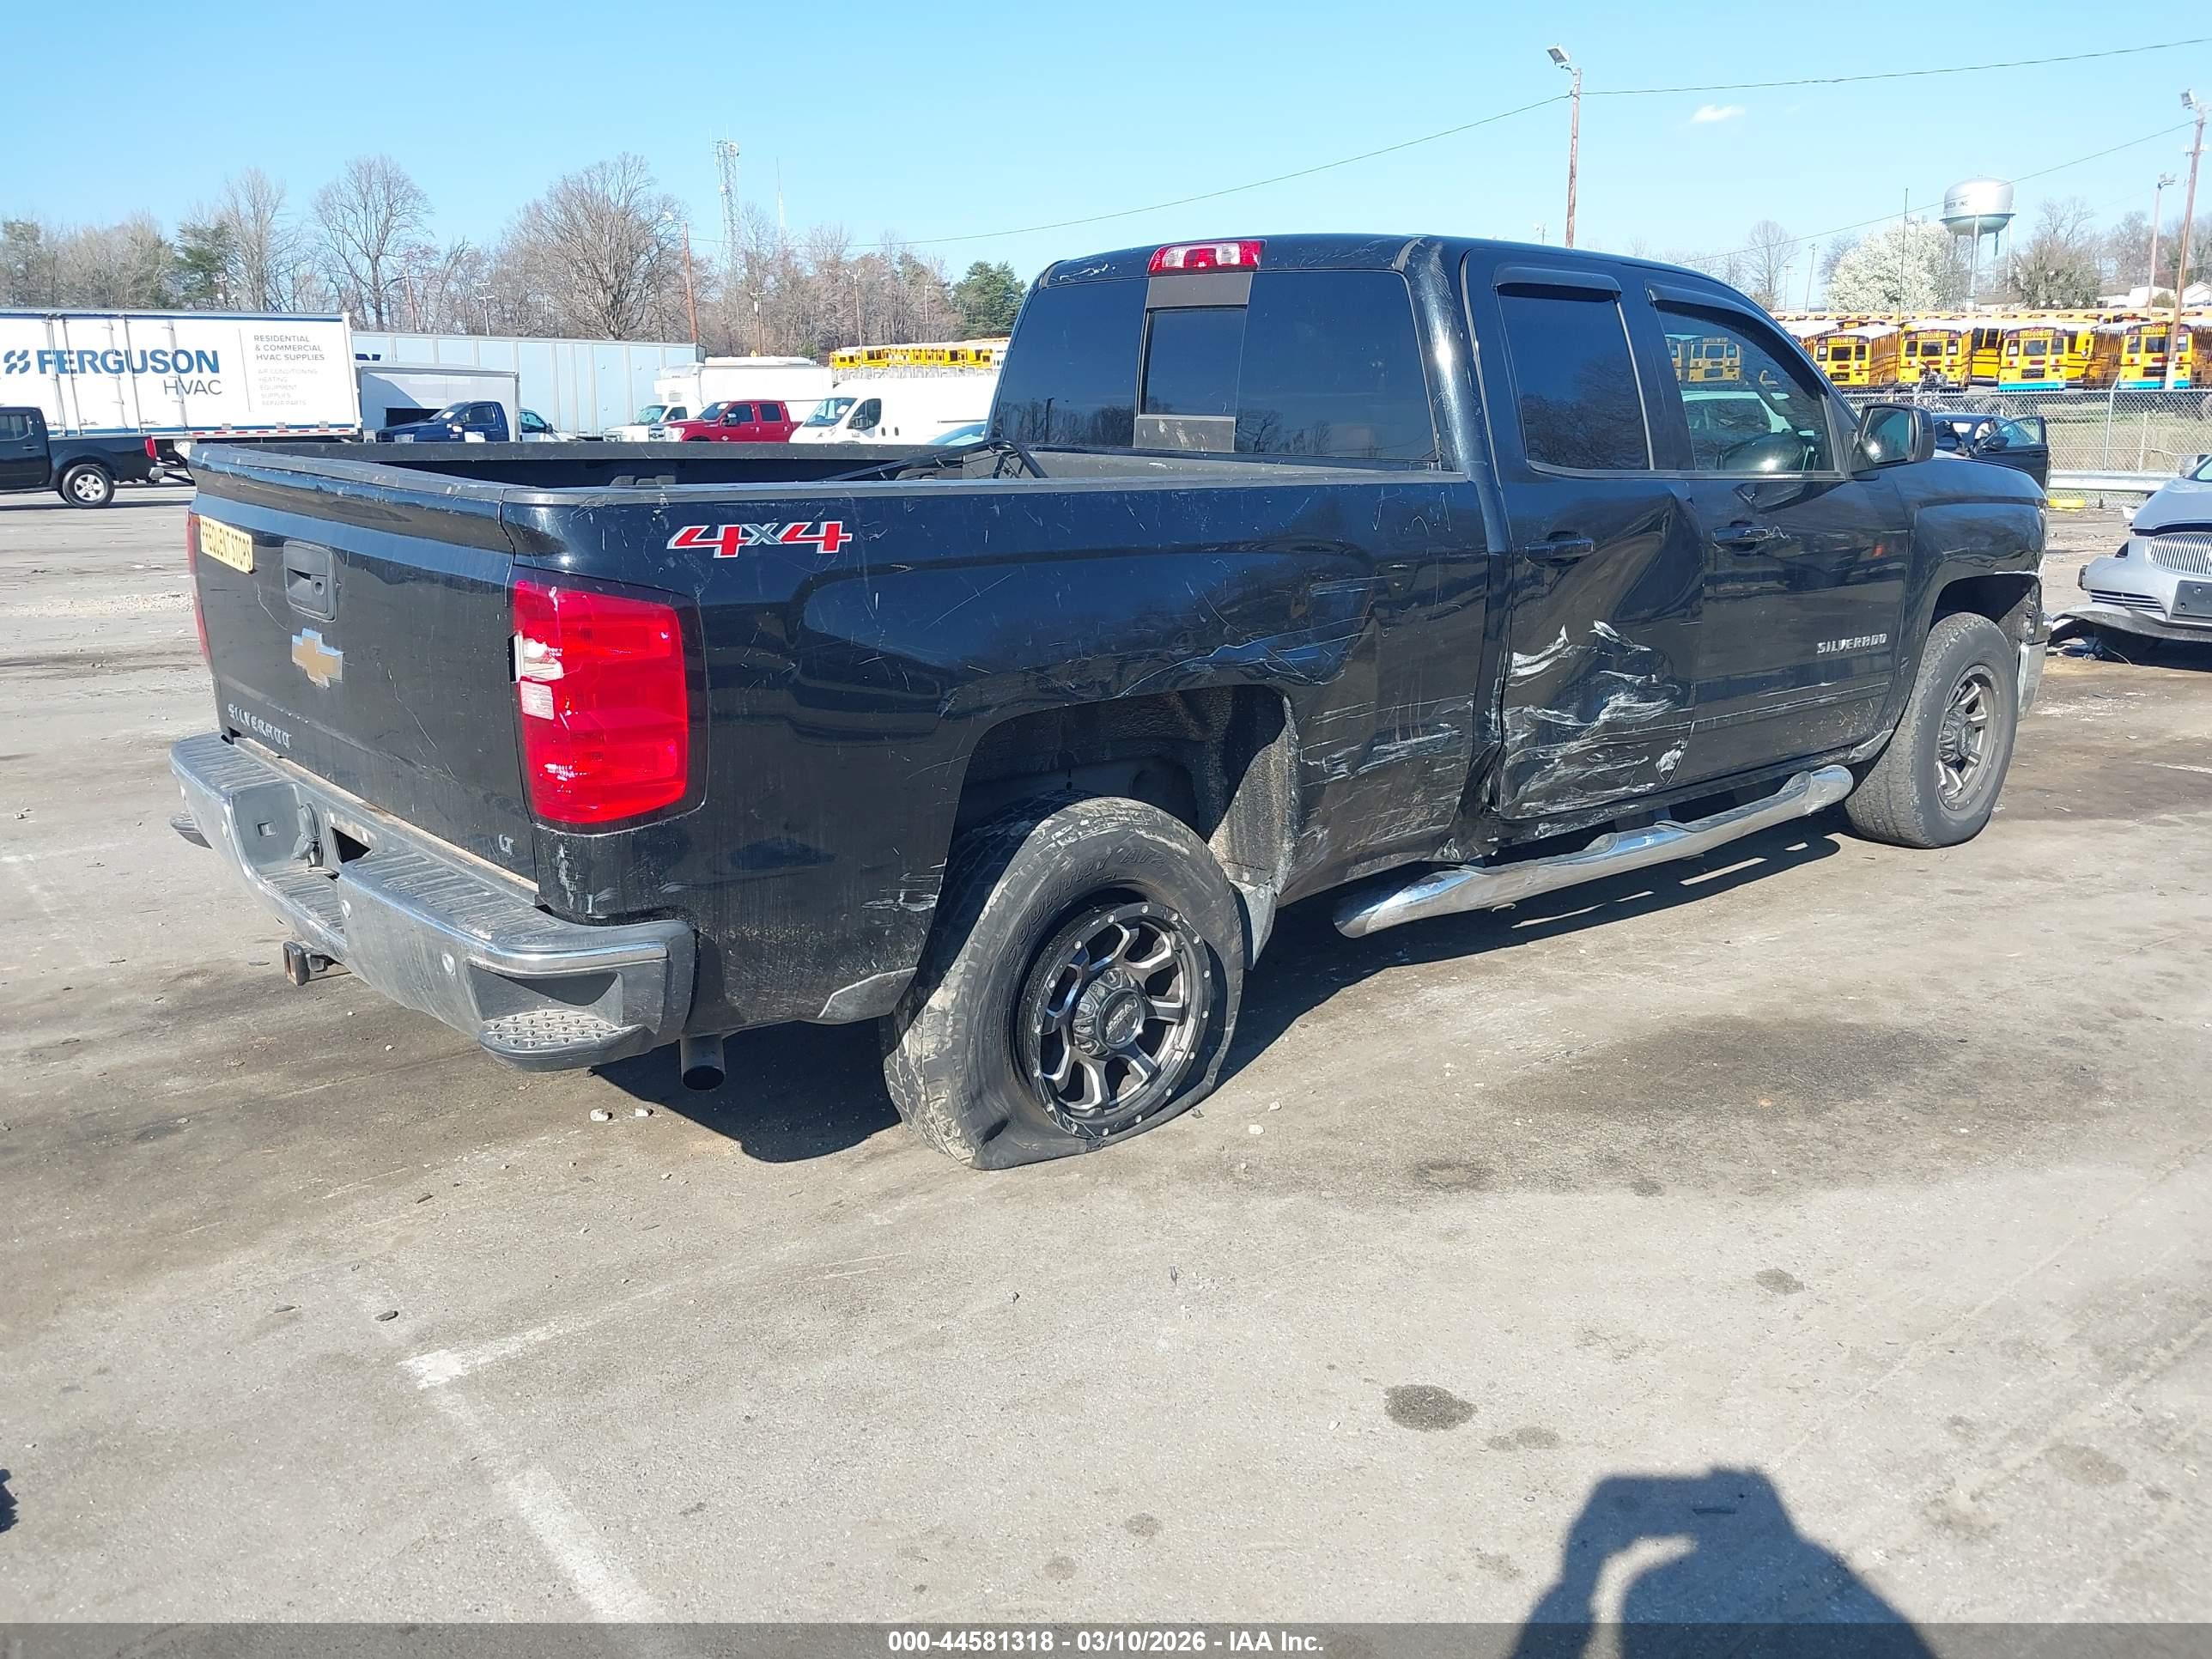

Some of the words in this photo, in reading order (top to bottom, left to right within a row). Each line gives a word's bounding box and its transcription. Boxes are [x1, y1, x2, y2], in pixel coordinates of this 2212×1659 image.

[253, 334, 310, 343] RESIDENTIAL
[36, 349, 220, 374] FERGUSON
[163, 379, 222, 395] HVAC
[231, 533, 252, 569] STOPS
[1816, 633, 1887, 654] SILVERADO
[228, 703, 292, 749] SILVERADO
